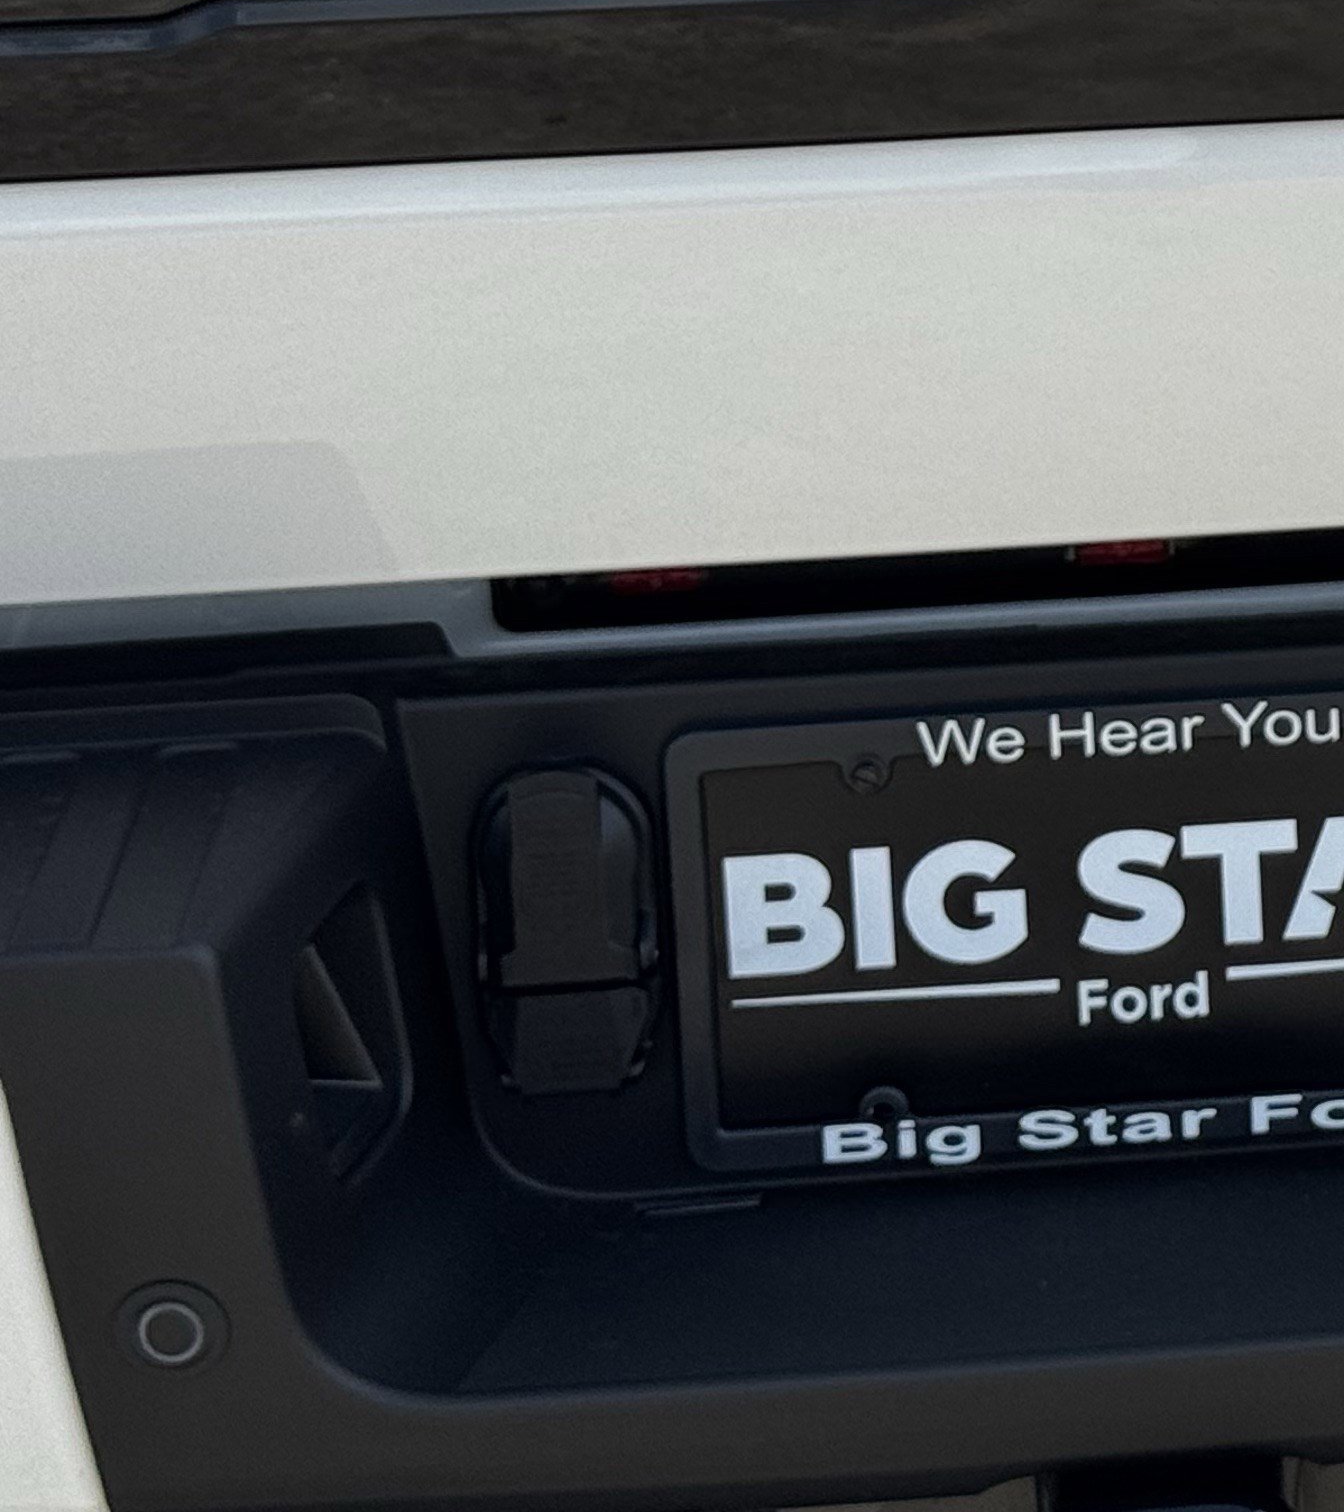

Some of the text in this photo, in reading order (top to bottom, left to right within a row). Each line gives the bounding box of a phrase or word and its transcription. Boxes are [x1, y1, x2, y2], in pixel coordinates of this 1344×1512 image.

[916, 699, 1341, 767] We Hear You
[722, 839, 1029, 981] BIG
[1076, 970, 1211, 1026] Ford
[821, 1119, 983, 1166] Big
[1017, 1102, 1218, 1151] Star
